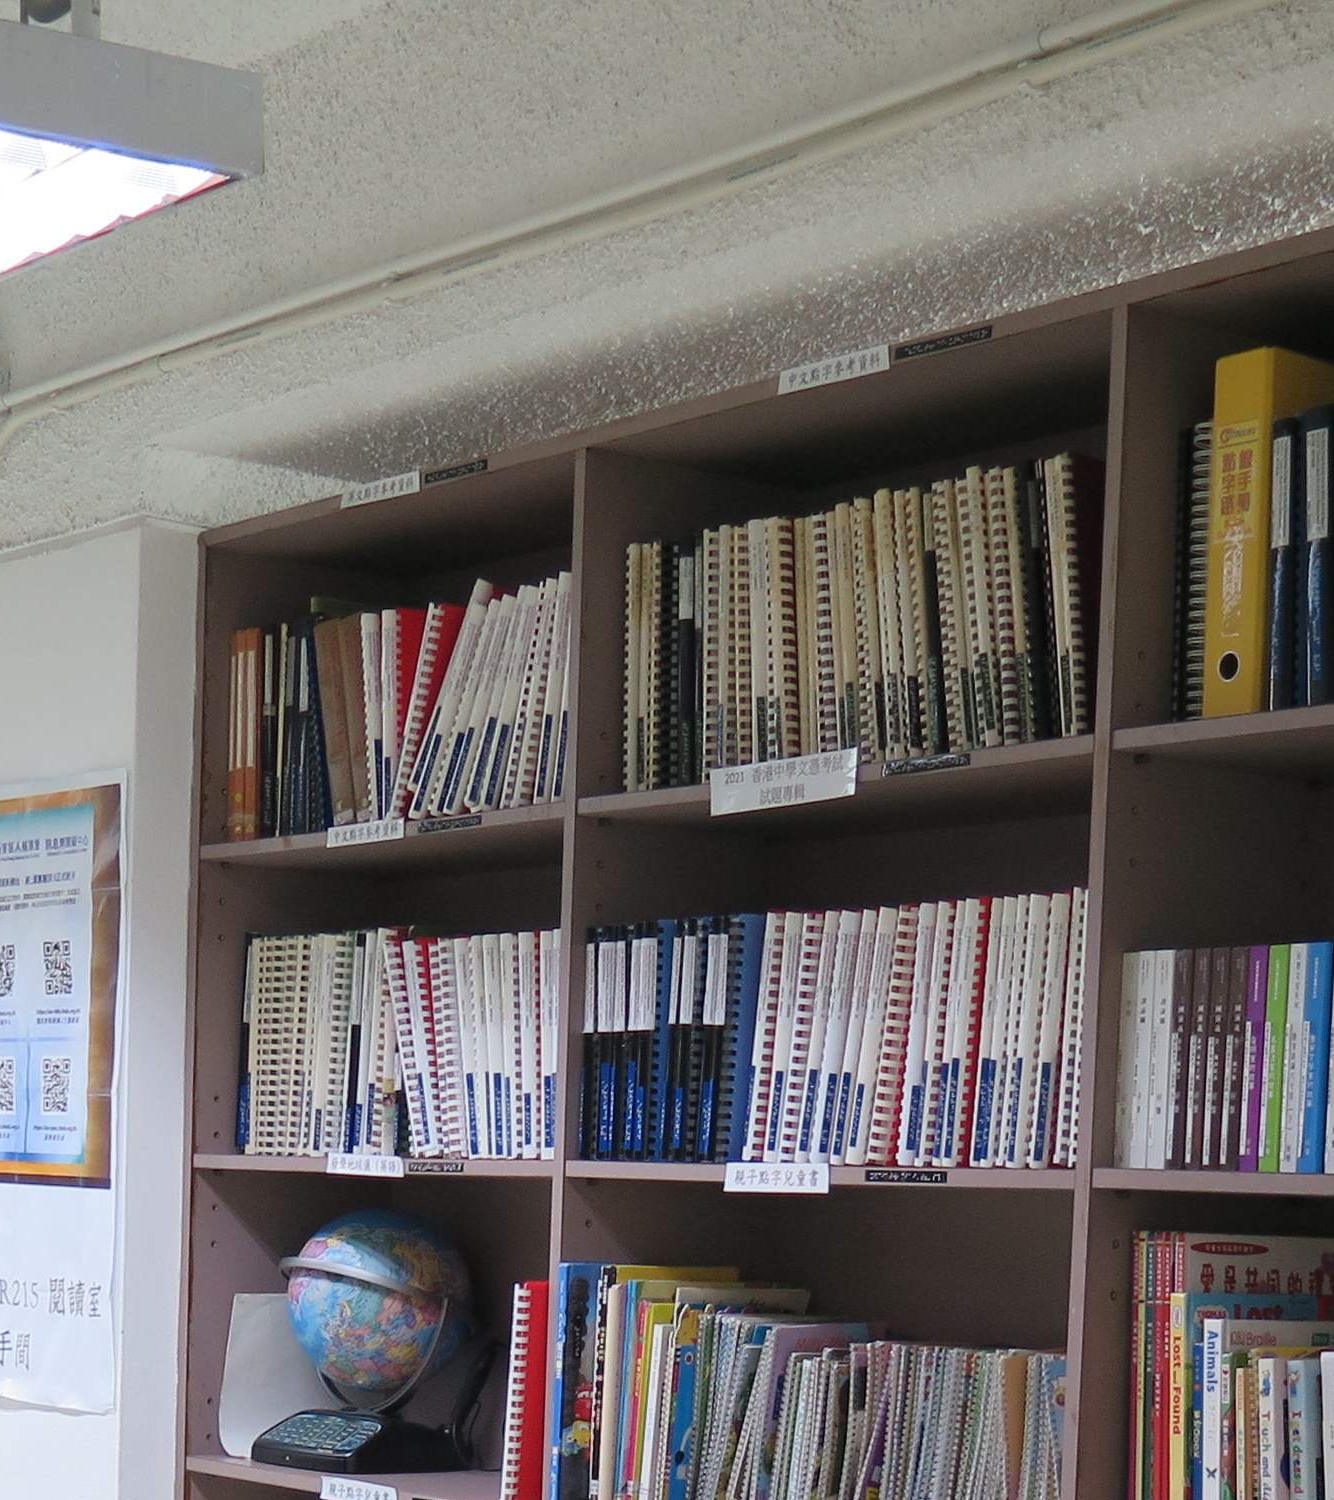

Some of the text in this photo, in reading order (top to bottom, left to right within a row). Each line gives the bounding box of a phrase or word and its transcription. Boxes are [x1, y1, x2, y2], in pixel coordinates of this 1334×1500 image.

[48, 1277, 102, 1319] 閱讀室
[1172, 1336, 1182, 1368] Lost
[1246, 1331, 1277, 1346] Braille
[1207, 1330, 1219, 1393] Animals
[1172, 1386, 1182, 1435] Found
